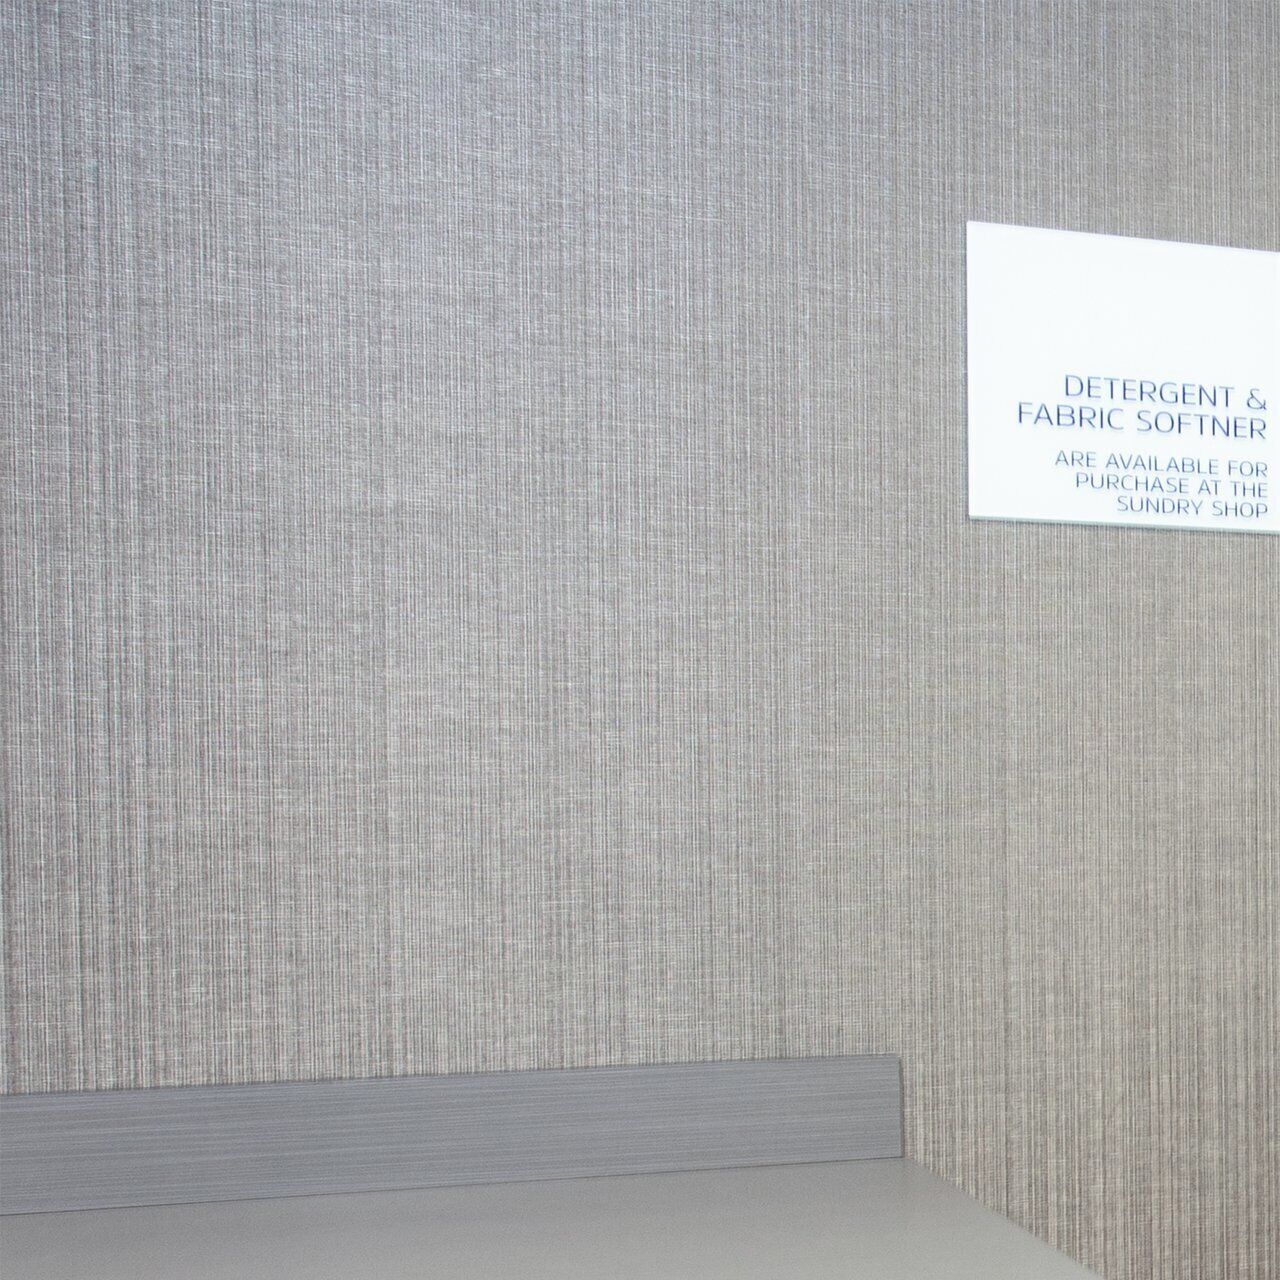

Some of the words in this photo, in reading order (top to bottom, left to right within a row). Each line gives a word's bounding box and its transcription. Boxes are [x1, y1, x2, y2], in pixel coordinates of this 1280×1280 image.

[1065, 374, 1235, 408] DETERGENT
[1247, 389, 1267, 411] &
[1019, 402, 1123, 430] FABRIC
[1137, 410, 1266, 439] SOFTNER
[1055, 450, 1096, 467] ARE
[1105, 452, 1219, 476] AVAILABLE
[1228, 460, 1267, 477] FOR
[1076, 472, 1188, 494] PURCHASE
[1198, 479, 1221, 495] AT
[1230, 481, 1267, 498] THE
[1118, 496, 1203, 515] SUNDRY
[1212, 501, 1268, 518] SHOP
